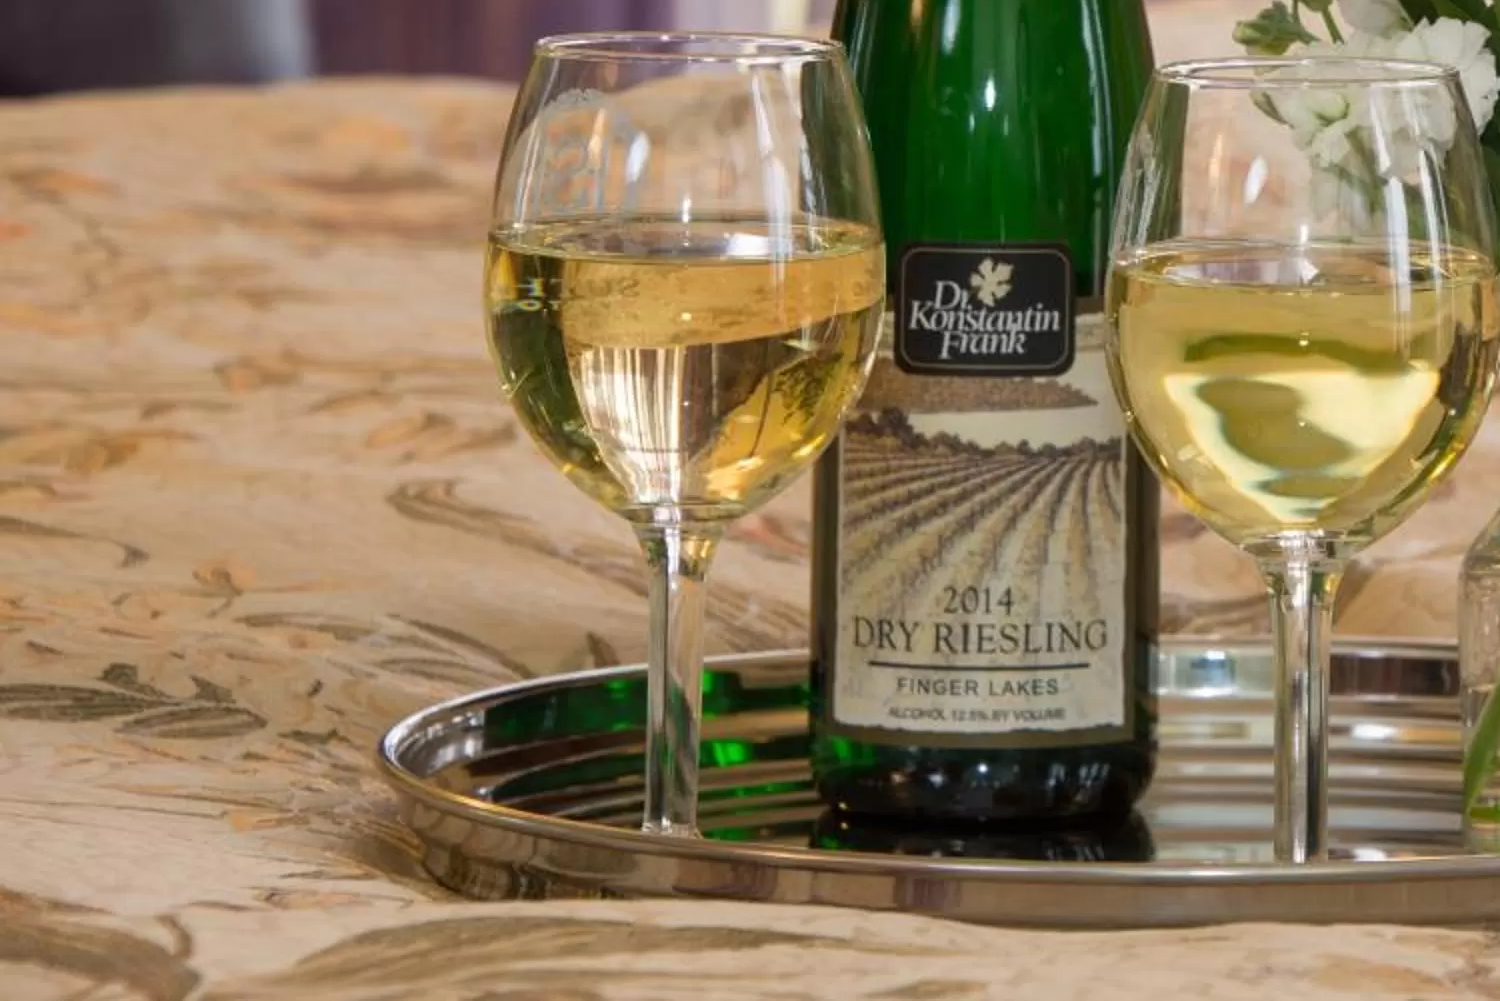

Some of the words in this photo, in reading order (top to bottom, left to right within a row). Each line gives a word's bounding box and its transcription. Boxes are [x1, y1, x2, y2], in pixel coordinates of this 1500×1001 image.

[933, 279, 973, 311] Dr.
[908, 299, 1061, 333] Konstantin
[938, 322, 1028, 360] Frank
[942, 585, 1016, 615] 2014
[852, 615, 920, 653] DRY
[933, 618, 1108, 655] RIESLING
[896, 676, 980, 697] FINGER
[988, 677, 1060, 697] LAKES
